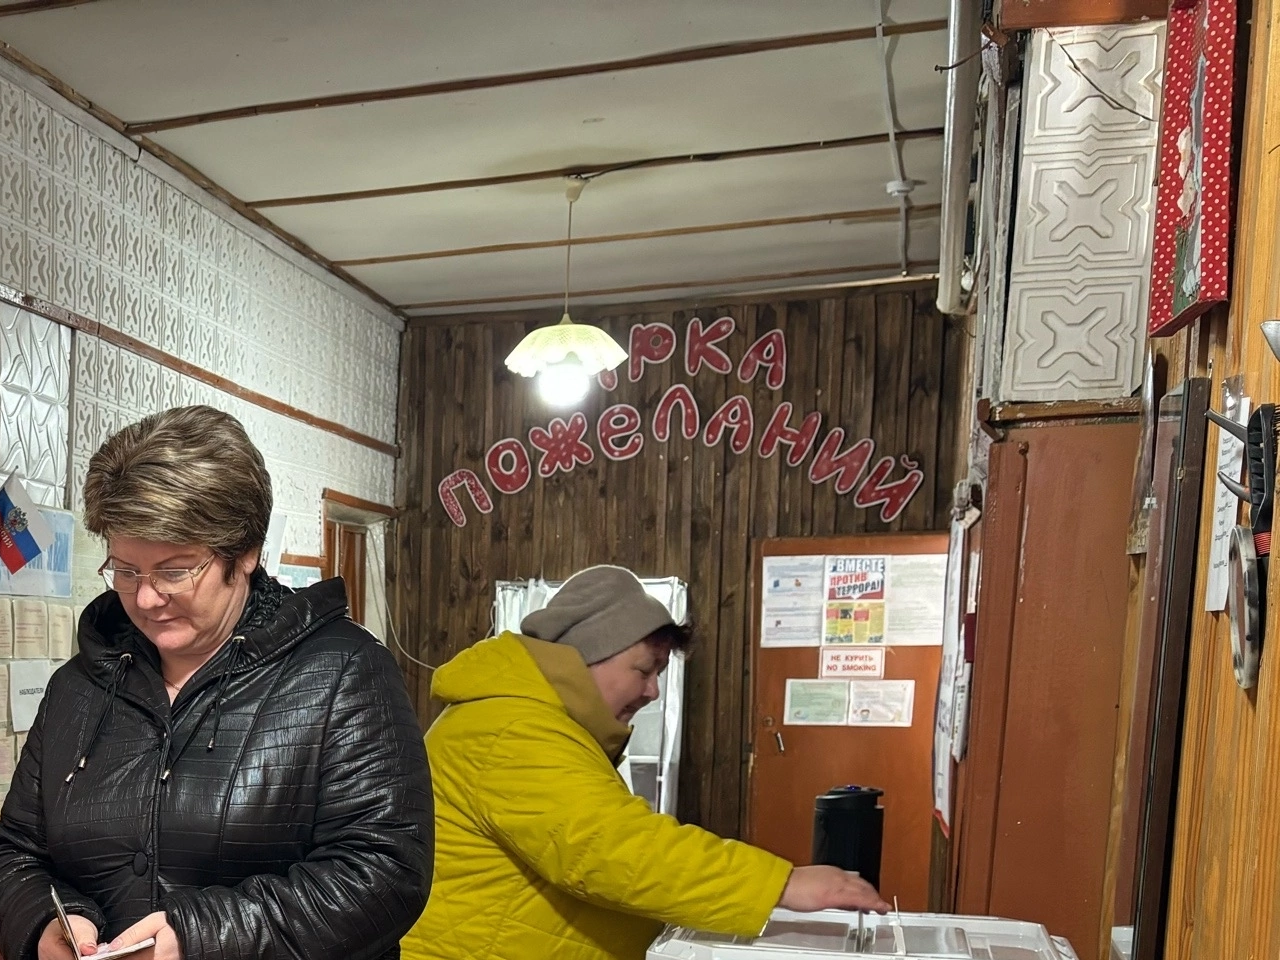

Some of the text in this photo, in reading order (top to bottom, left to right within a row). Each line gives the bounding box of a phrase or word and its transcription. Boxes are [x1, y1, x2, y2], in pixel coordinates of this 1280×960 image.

[599, 316, 786, 391] РКА
[836, 557, 885, 572] ВМЕСТЕ
[830, 572, 867, 586] ПРОТИВ
[836, 580, 880, 596] ТЕРРОРА!
